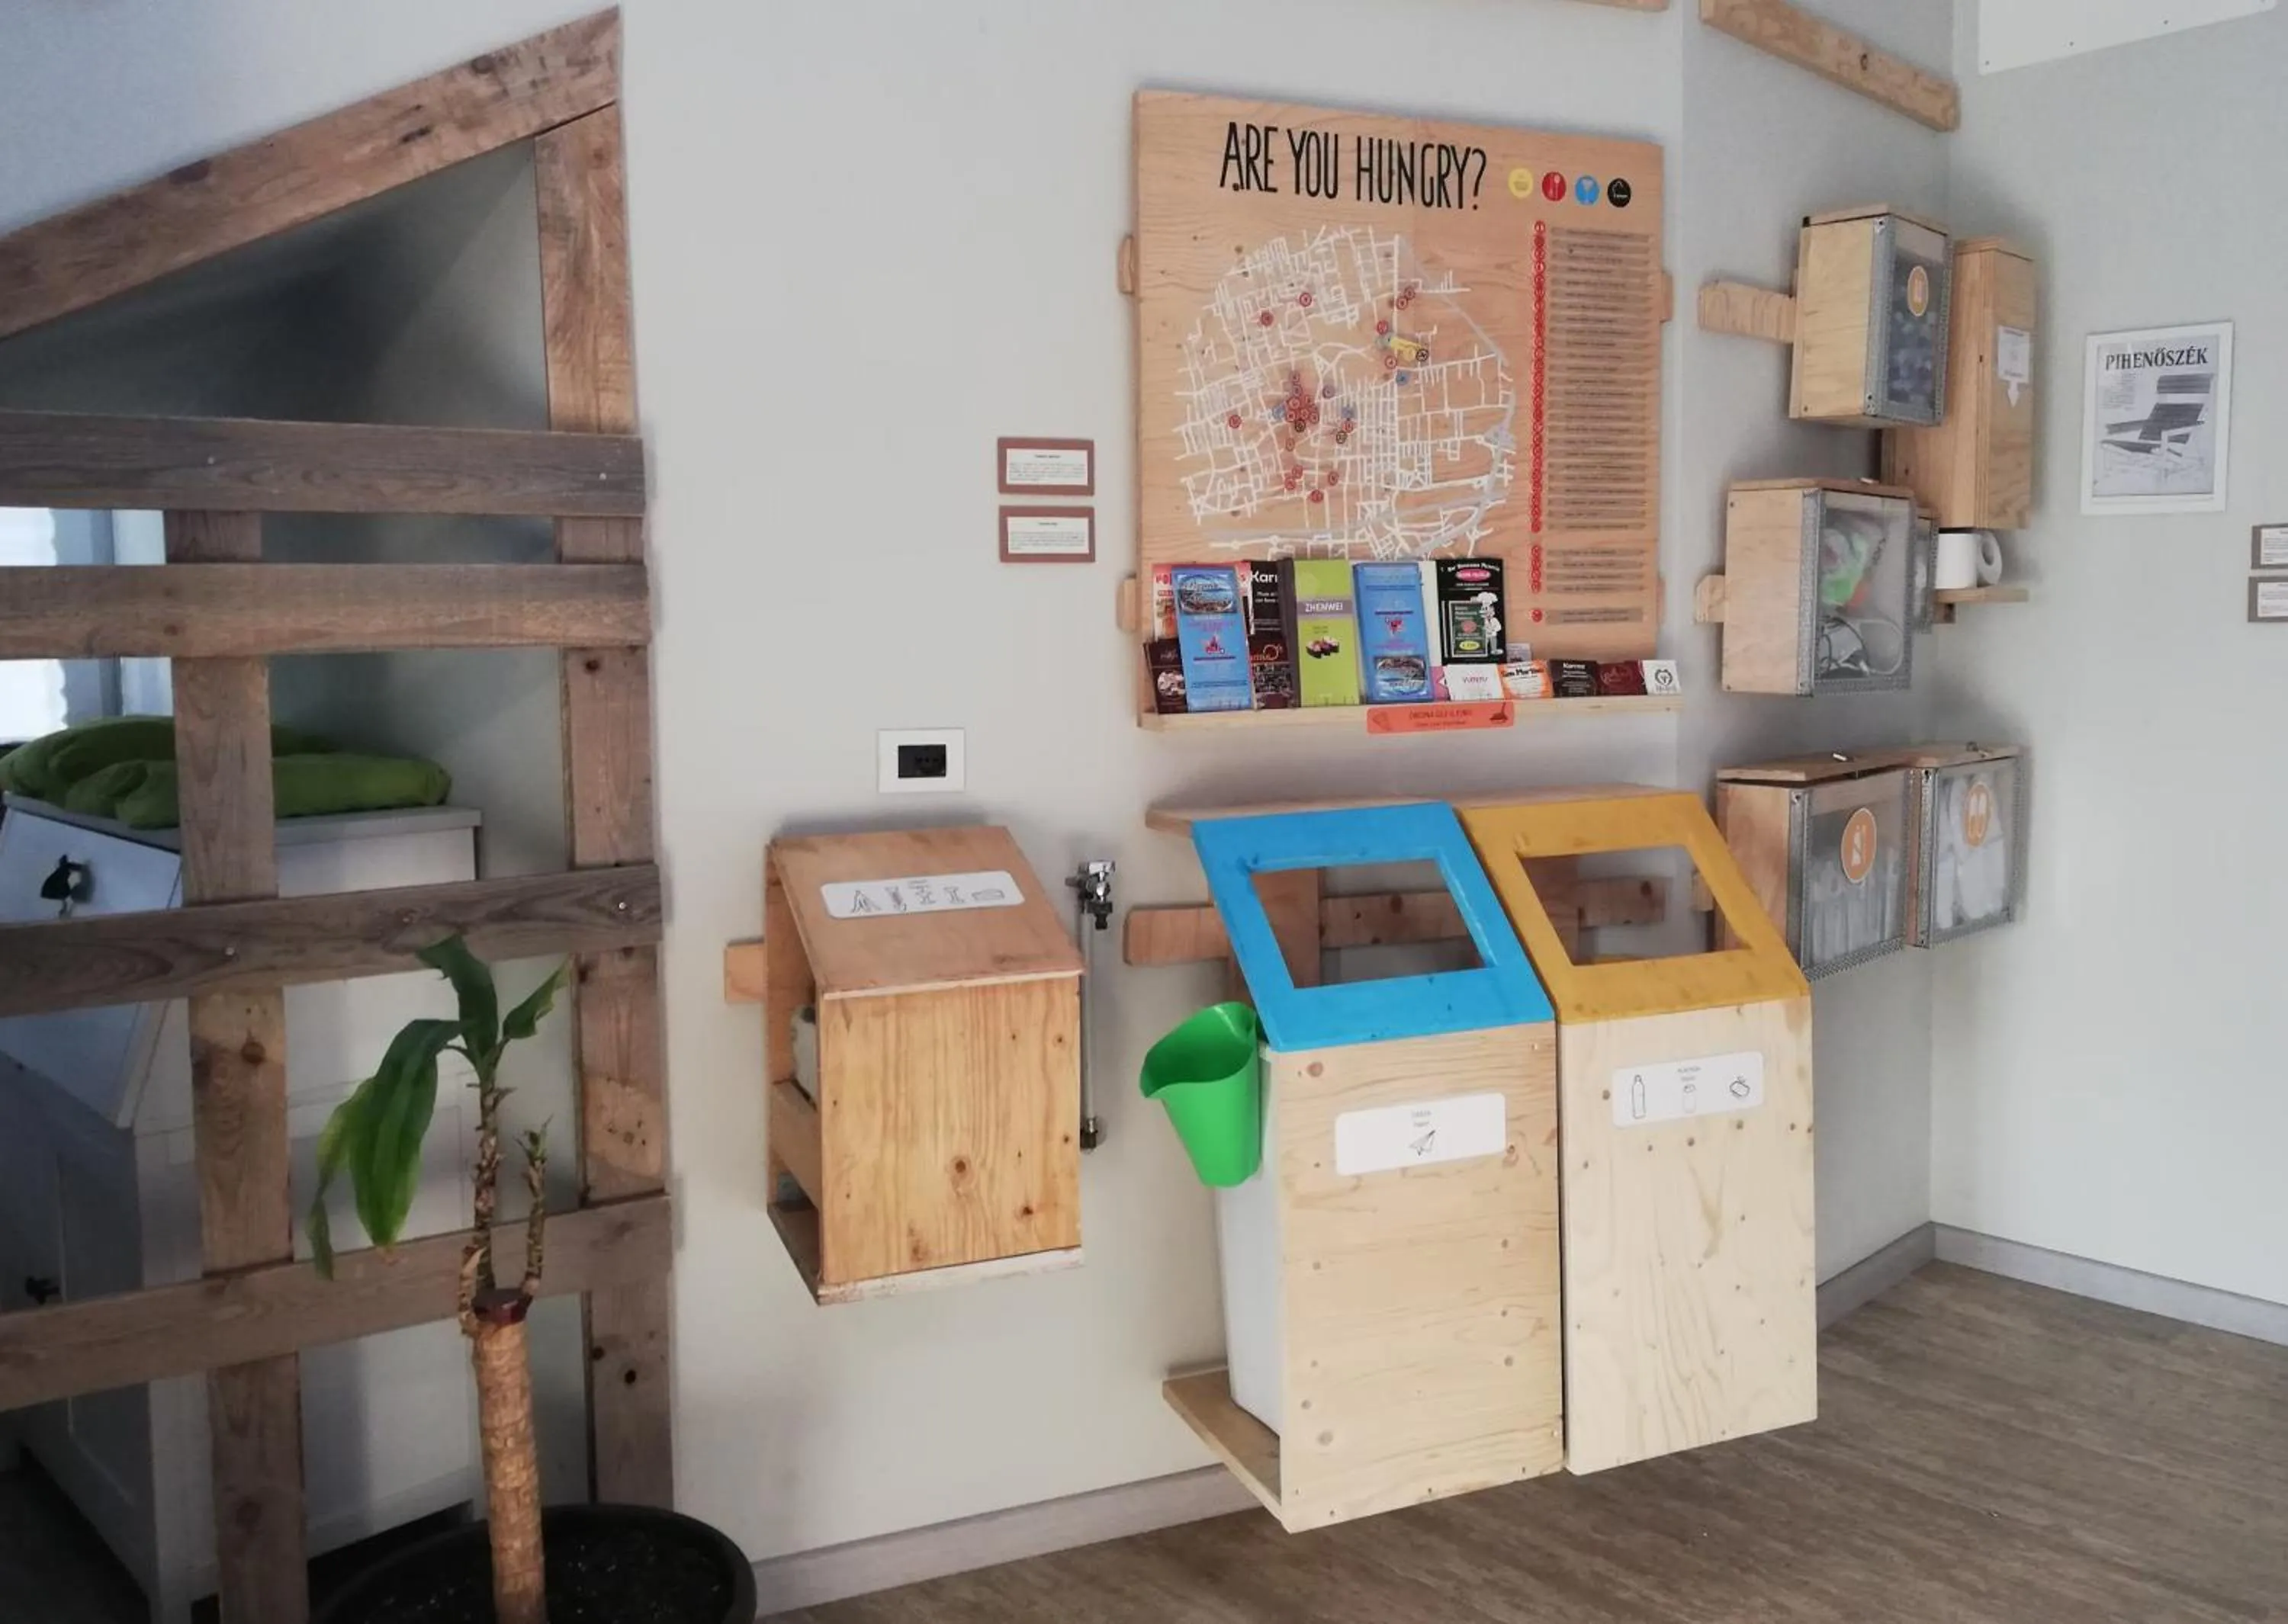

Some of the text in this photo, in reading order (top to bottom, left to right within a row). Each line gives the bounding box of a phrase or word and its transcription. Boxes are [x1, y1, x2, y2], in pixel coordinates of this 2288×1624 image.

[1220, 122, 1487, 210] ARE YOU HUNGRY?
[2106, 345, 2209, 371] PIHENŐSZÉK
